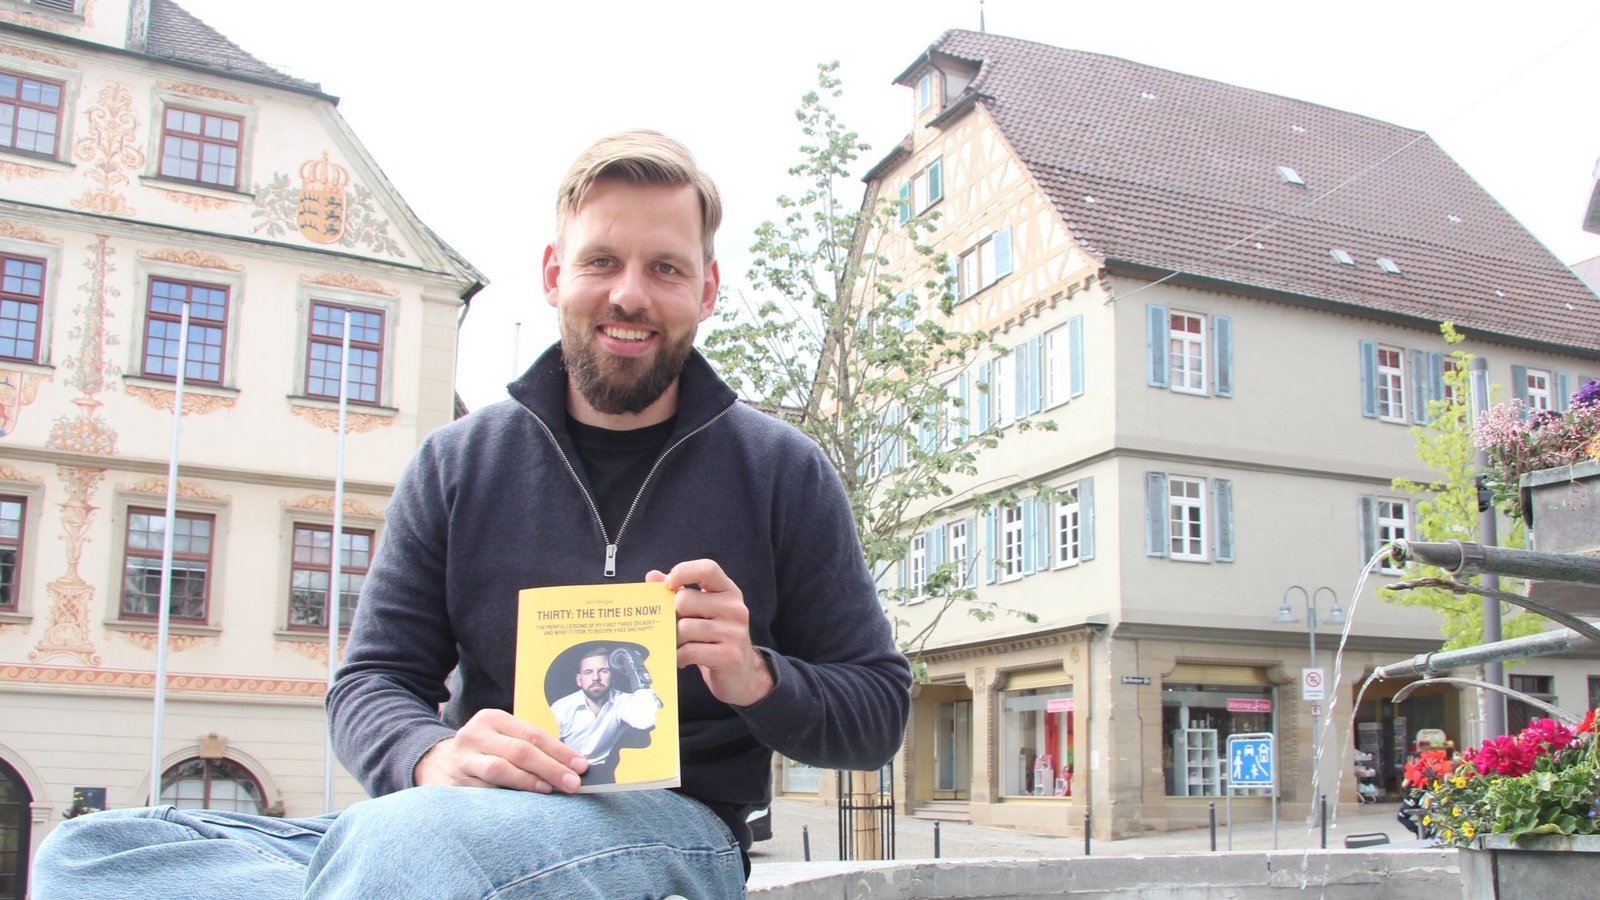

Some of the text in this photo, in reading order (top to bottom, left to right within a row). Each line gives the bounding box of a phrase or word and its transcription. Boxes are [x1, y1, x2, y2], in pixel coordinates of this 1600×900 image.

[537, 605, 661, 620] THIRTY: THE TIME IS NOW!
